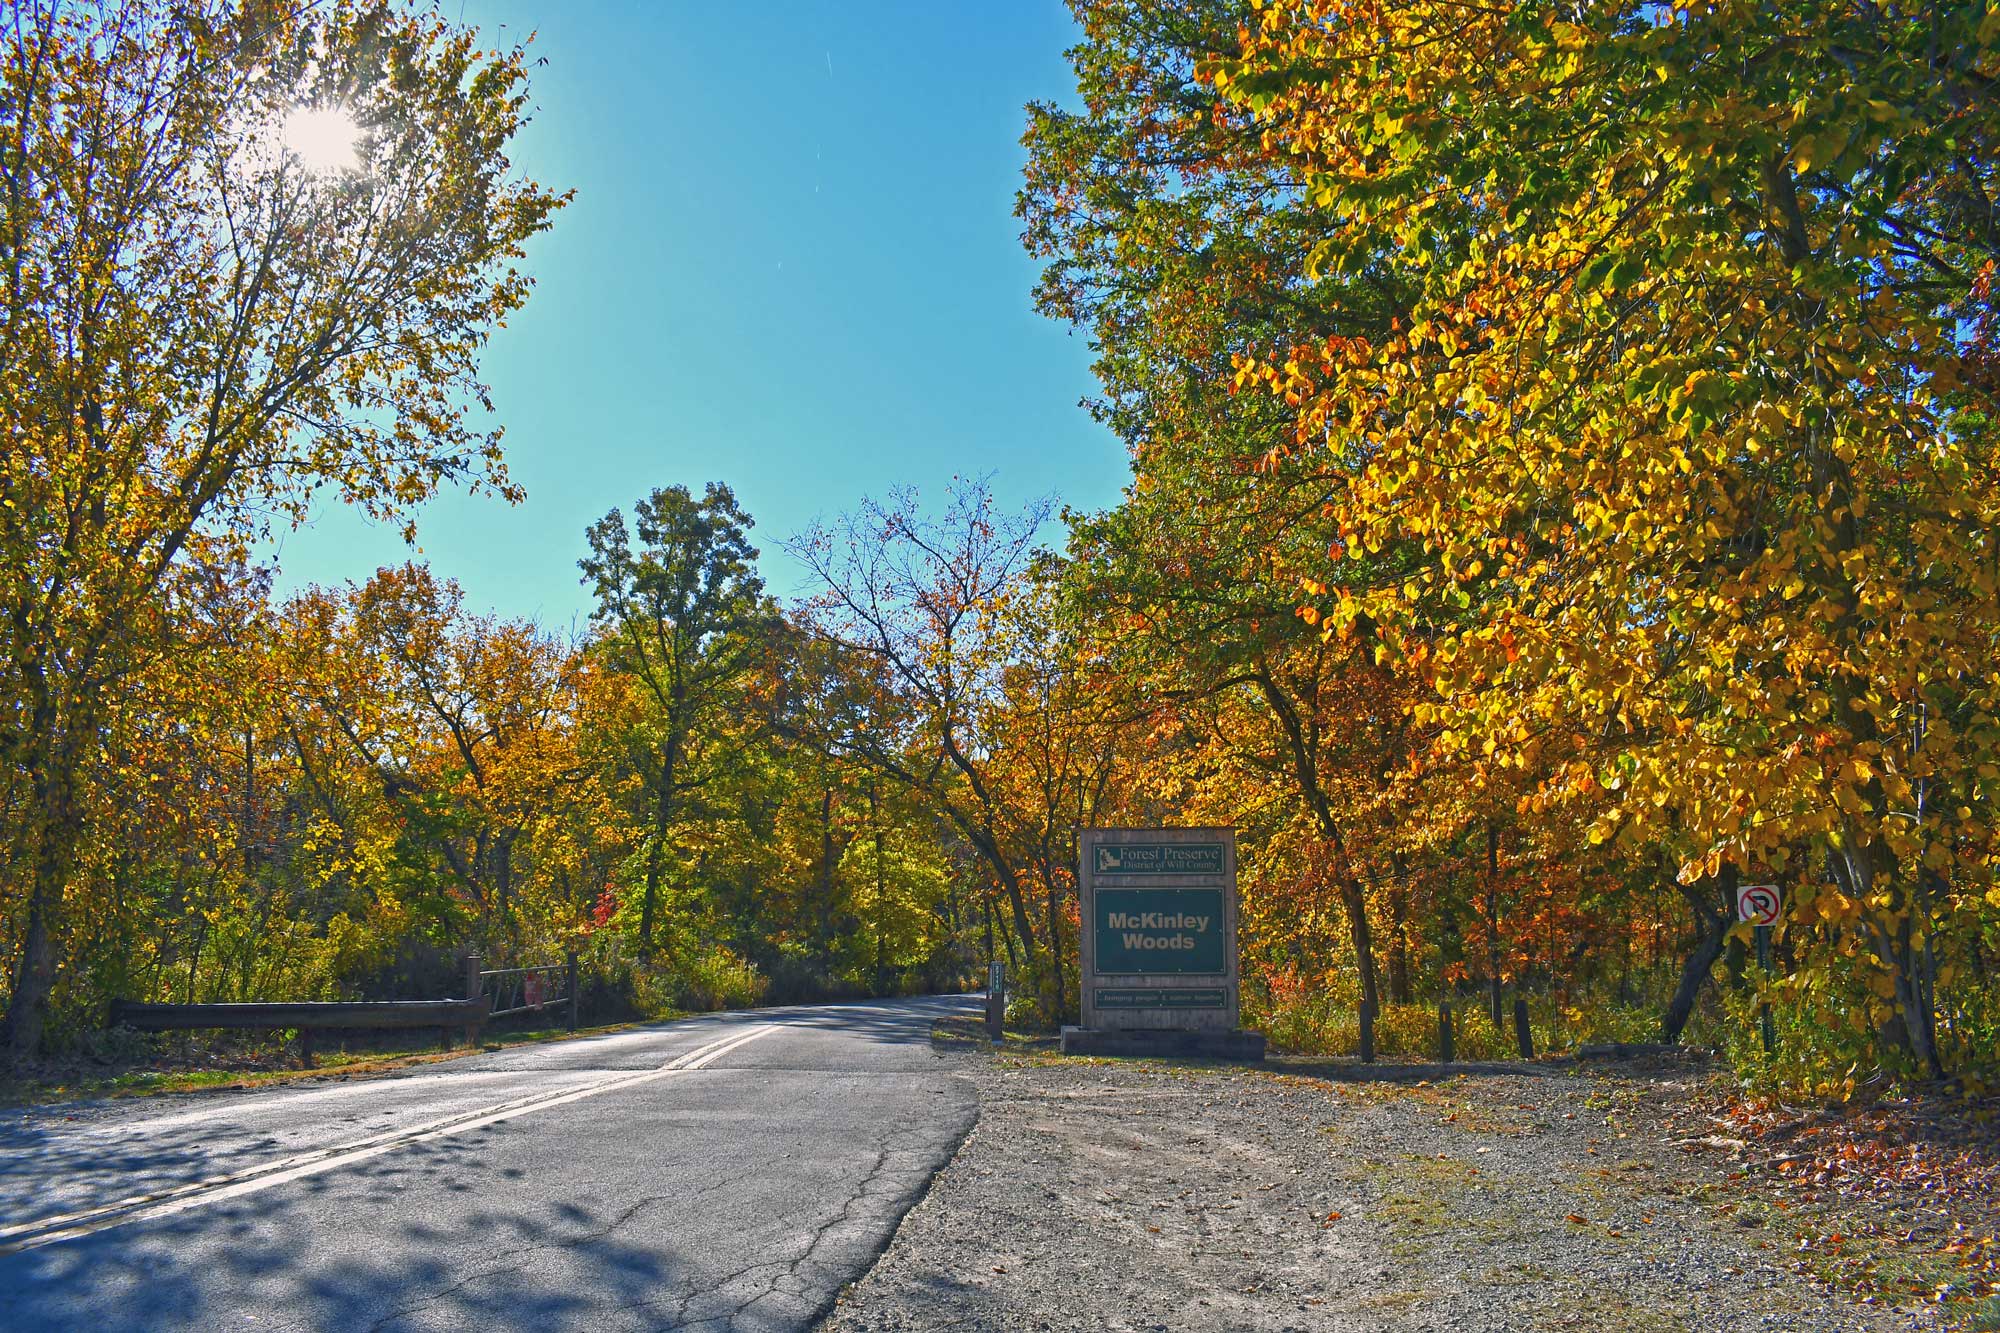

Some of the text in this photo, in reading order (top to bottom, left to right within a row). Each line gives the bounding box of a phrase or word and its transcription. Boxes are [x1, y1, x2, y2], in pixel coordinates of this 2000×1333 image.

[1120, 847, 1218, 860] Forest Preserve
[1124, 860, 1217, 871] District of Will County
[1108, 912, 1209, 932] McKinley
[1122, 933, 1195, 949] Woods
